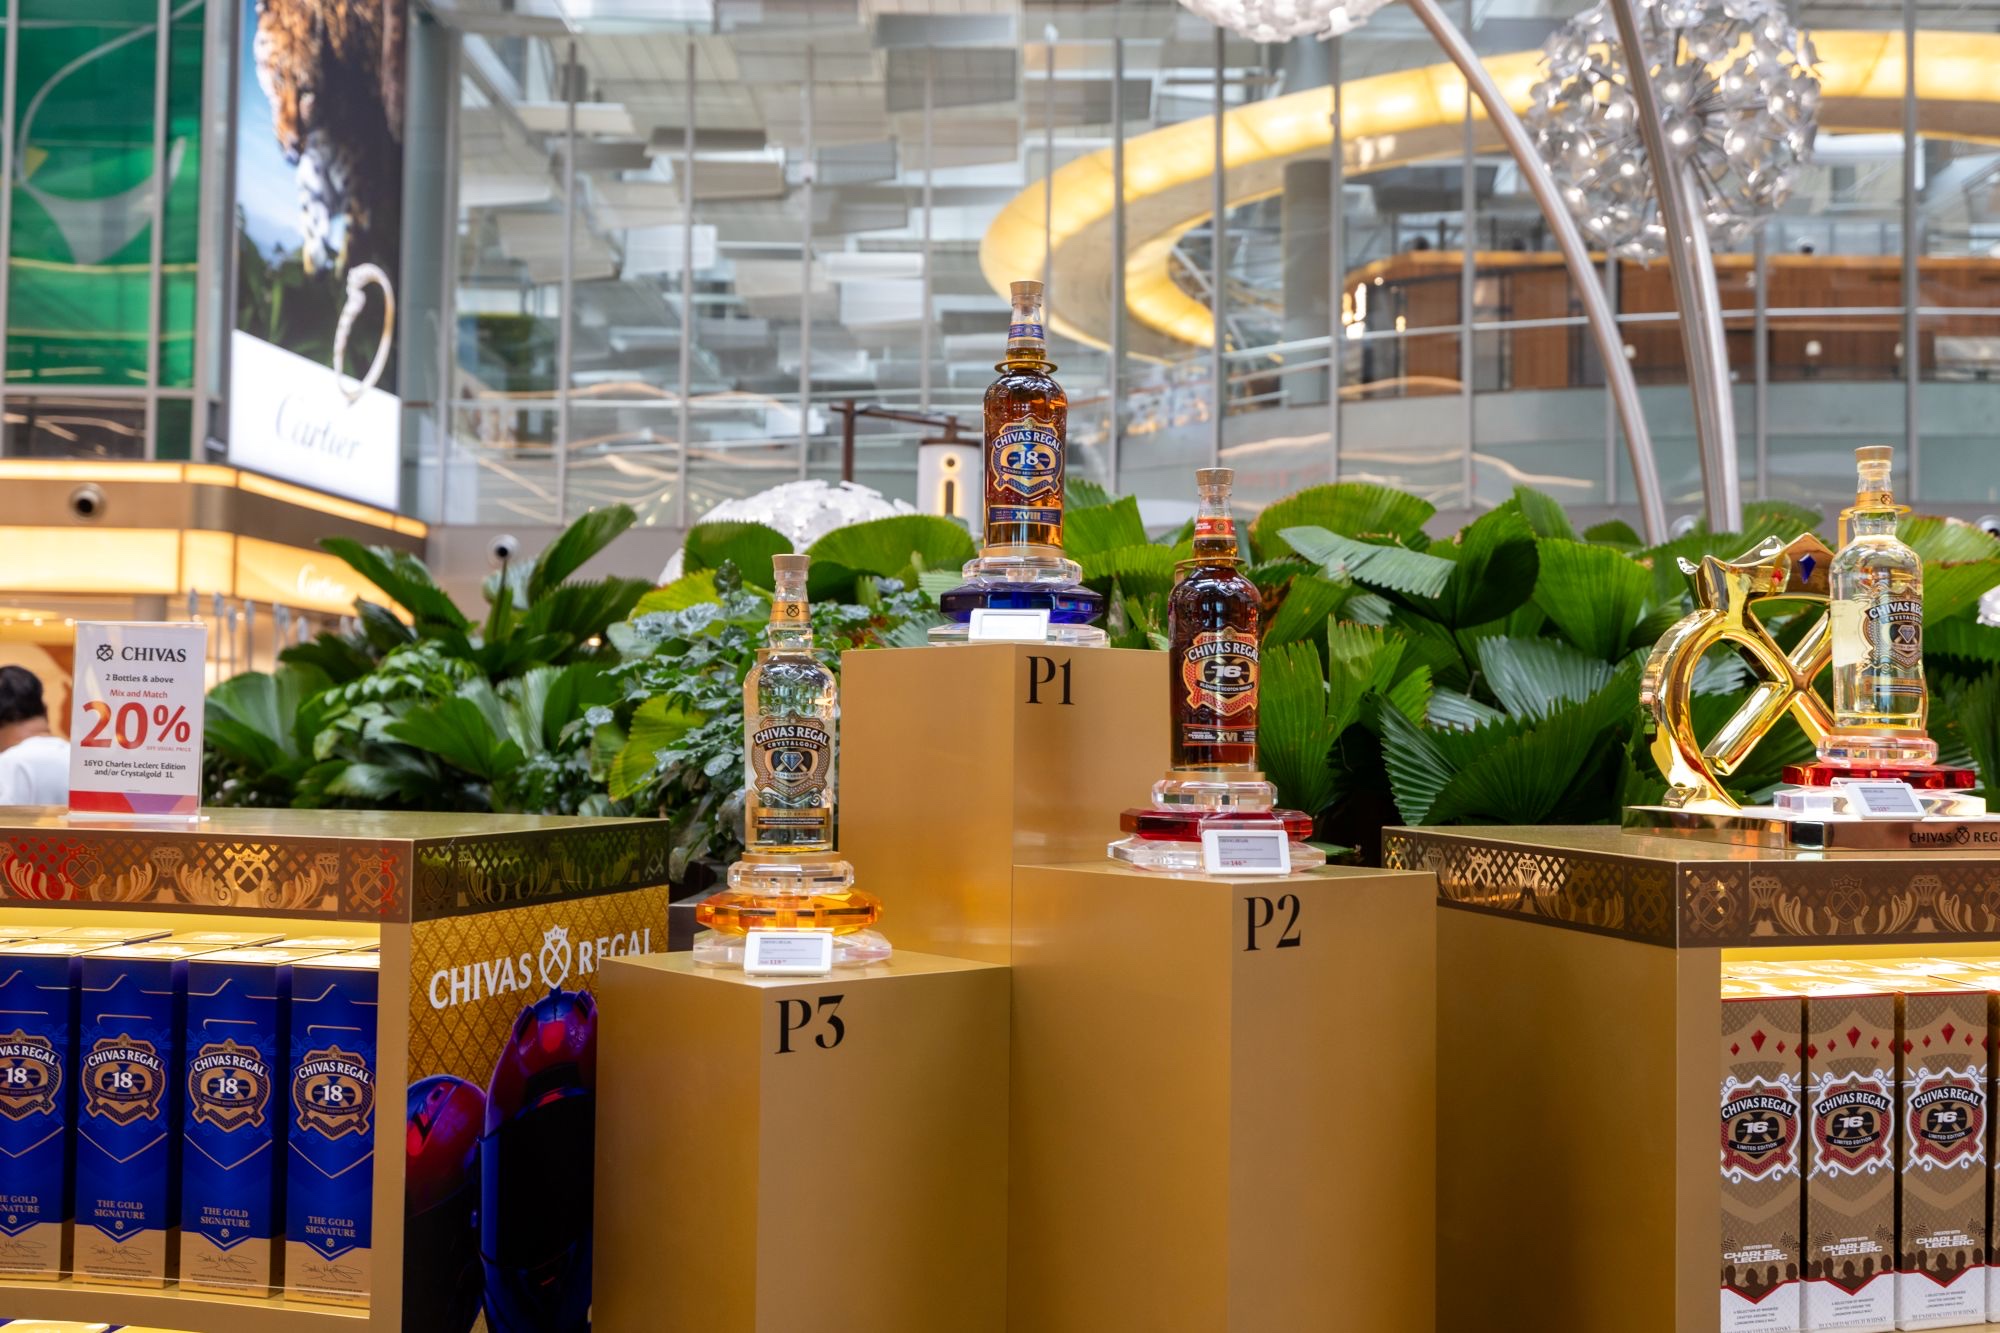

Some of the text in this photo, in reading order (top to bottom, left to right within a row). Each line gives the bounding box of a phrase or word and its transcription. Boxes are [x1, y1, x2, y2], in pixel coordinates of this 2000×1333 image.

[276, 393, 361, 460] Cartier
[995, 432, 1060, 452] CHIVAS REGAL
[1018, 451, 1038, 465] 18
[1016, 512, 1040, 520] XVIII
[1869, 602, 1909, 618] CHIVAS
[122, 646, 186, 662] CHIVAS
[1188, 642, 1258, 662] CHIVAS REGAL
[1211, 665, 1241, 678] 16
[112, 674, 140, 682] Bottles
[142, 674, 148, 682] &
[150, 675, 174, 684] above
[1025, 656, 1075, 705] P1
[110, 689, 168, 699] Mix and Match
[80, 700, 190, 750] 20%
[755, 726, 827, 745] CHIVAS REGAL
[1216, 731, 1238, 742] XVI
[768, 740, 817, 749] CRYSTALGOLD
[105, 760, 132, 768] Charles
[133, 761, 159, 769] Leclerc
[161, 762, 186, 770] Edition
[94, 768, 118, 776] and/or
[120, 769, 162, 779] Crystalgold
[1909, 832, 1952, 843] CHIVAS
[1243, 894, 1301, 952] P2
[429, 953, 532, 1009] CHIVAS
[774, 995, 844, 1055] P3
[22, 1046, 56, 1065] REGAL
[88, 1050, 159, 1071] CHIVAS REGAL
[194, 1055, 264, 1077] CHIVAS REGAL
[298, 1061, 369, 1083] CHIVAS REGAL
[5, 1067, 27, 1083] 18
[112, 1072, 133, 1088] 18
[218, 1078, 238, 1094] 18
[322, 1085, 342, 1101] 18
[1914, 1088, 1979, 1108] CHIVAS REGAL
[1722, 1098, 1792, 1119] CHIVAS REGAL
[1819, 1093, 1887, 1117] CHIVAS REGAL
[1839, 1116, 1864, 1128] 16
[1934, 1112, 1957, 1122] 16
[1743, 1122, 1768, 1133] 16
[1757, 1142, 1777, 1150] EDITION
[1853, 1137, 1872, 1145] EDITION
[11, 1196, 38, 1204] GOLD
[97, 1200, 143, 1210] THE GOLD
[94, 1209, 145, 1219] SIGNATURE
[203, 1207, 248, 1218] THE GOLD
[200, 1216, 250, 1228] SIGNATURE
[308, 1216, 354, 1228] THE GOLD
[306, 1226, 356, 1237] SIGNATURE
[1916, 1235, 1967, 1244] CHARLES
[1925, 1239, 1974, 1248] LECLERC
[1822, 1240, 1876, 1252] CHARLES
[1832, 1246, 1882, 1256] LECLERC
[1724, 1249, 1780, 1260] CHARLES
[1734, 1254, 1788, 1263] LECLERC
